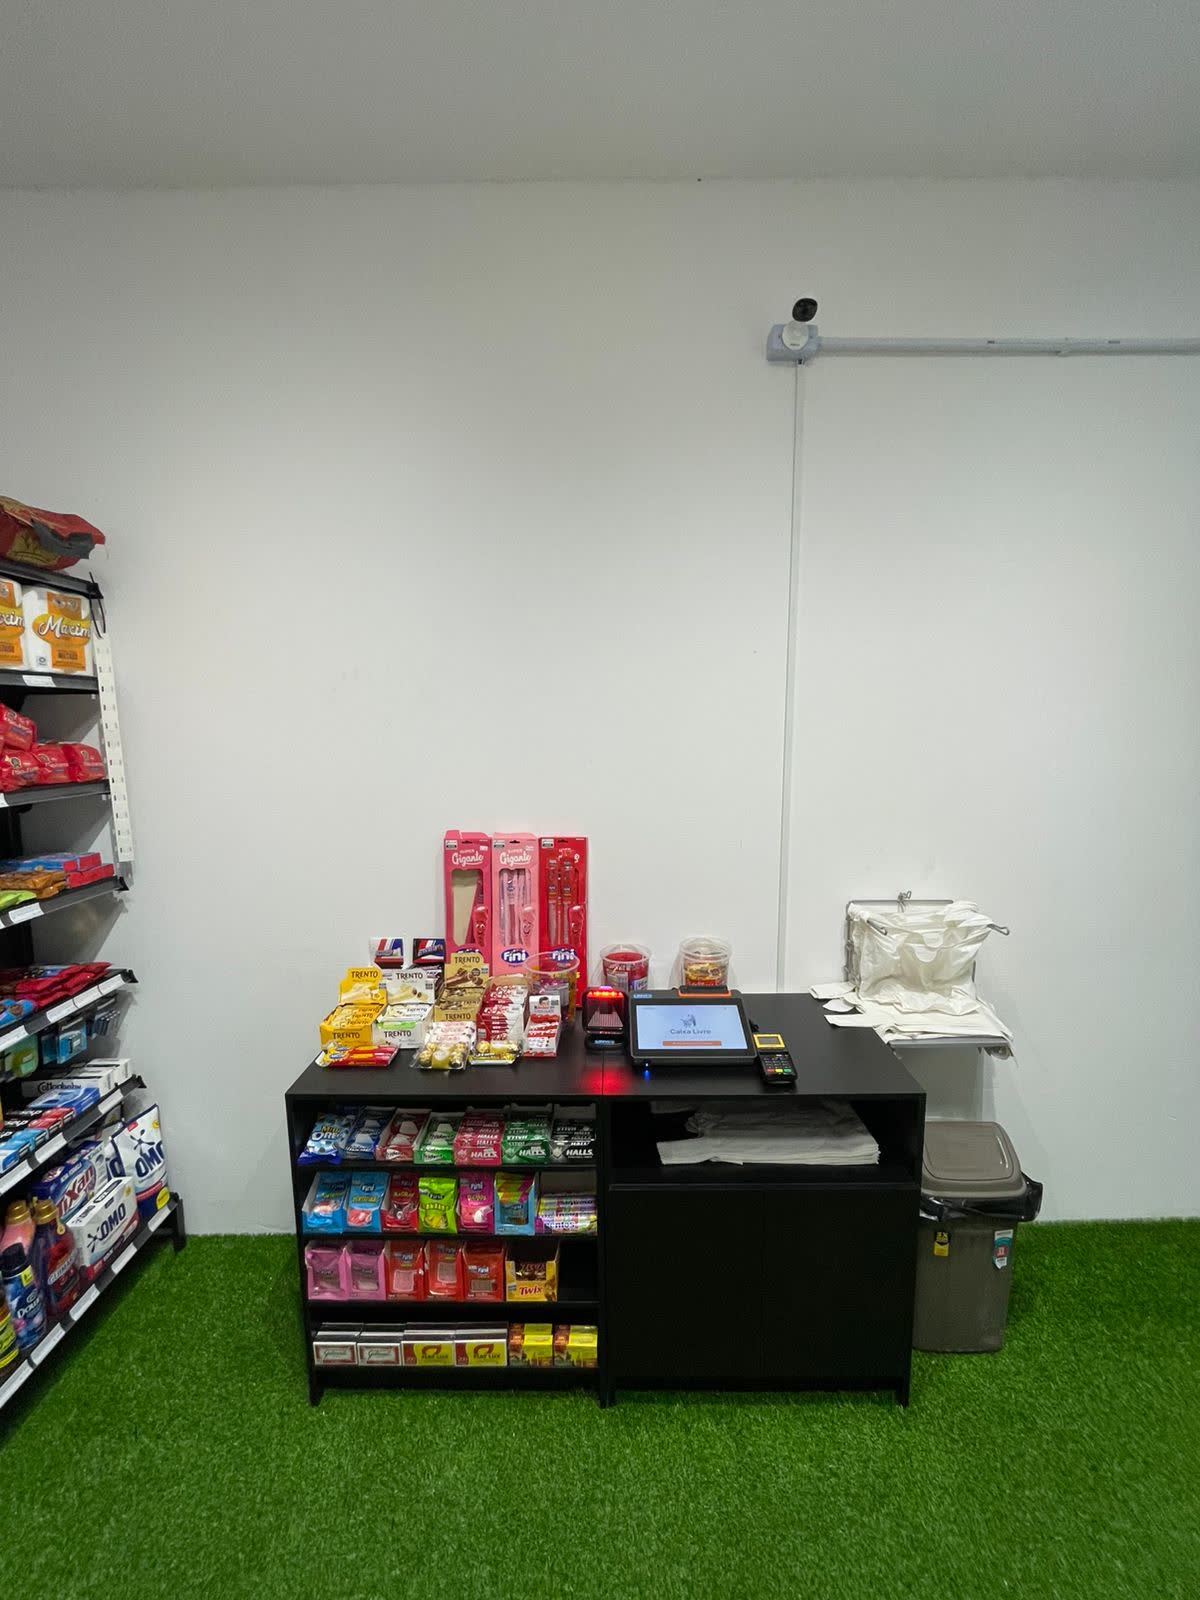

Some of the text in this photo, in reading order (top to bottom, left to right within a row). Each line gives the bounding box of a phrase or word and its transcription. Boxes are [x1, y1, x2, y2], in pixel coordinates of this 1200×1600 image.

[0, 610, 25, 627] xim
[38, 615, 91, 638] Maxim
[452, 851, 484, 867] Gigante
[499, 851, 532, 867] Gigante
[455, 956, 481, 964] TRENTO
[351, 970, 379, 979] TRENTO
[396, 972, 424, 980] TRENTO
[445, 1013, 471, 1021] TRENTO
[332, 1032, 361, 1040] TRENTO
[384, 1030, 412, 1038] TRENTO
[471, 1150, 498, 1159] HALLS
[518, 1149, 546, 1157] HALLS
[97, 1203, 127, 1242] OMO
[519, 1285, 543, 1296] Twix
